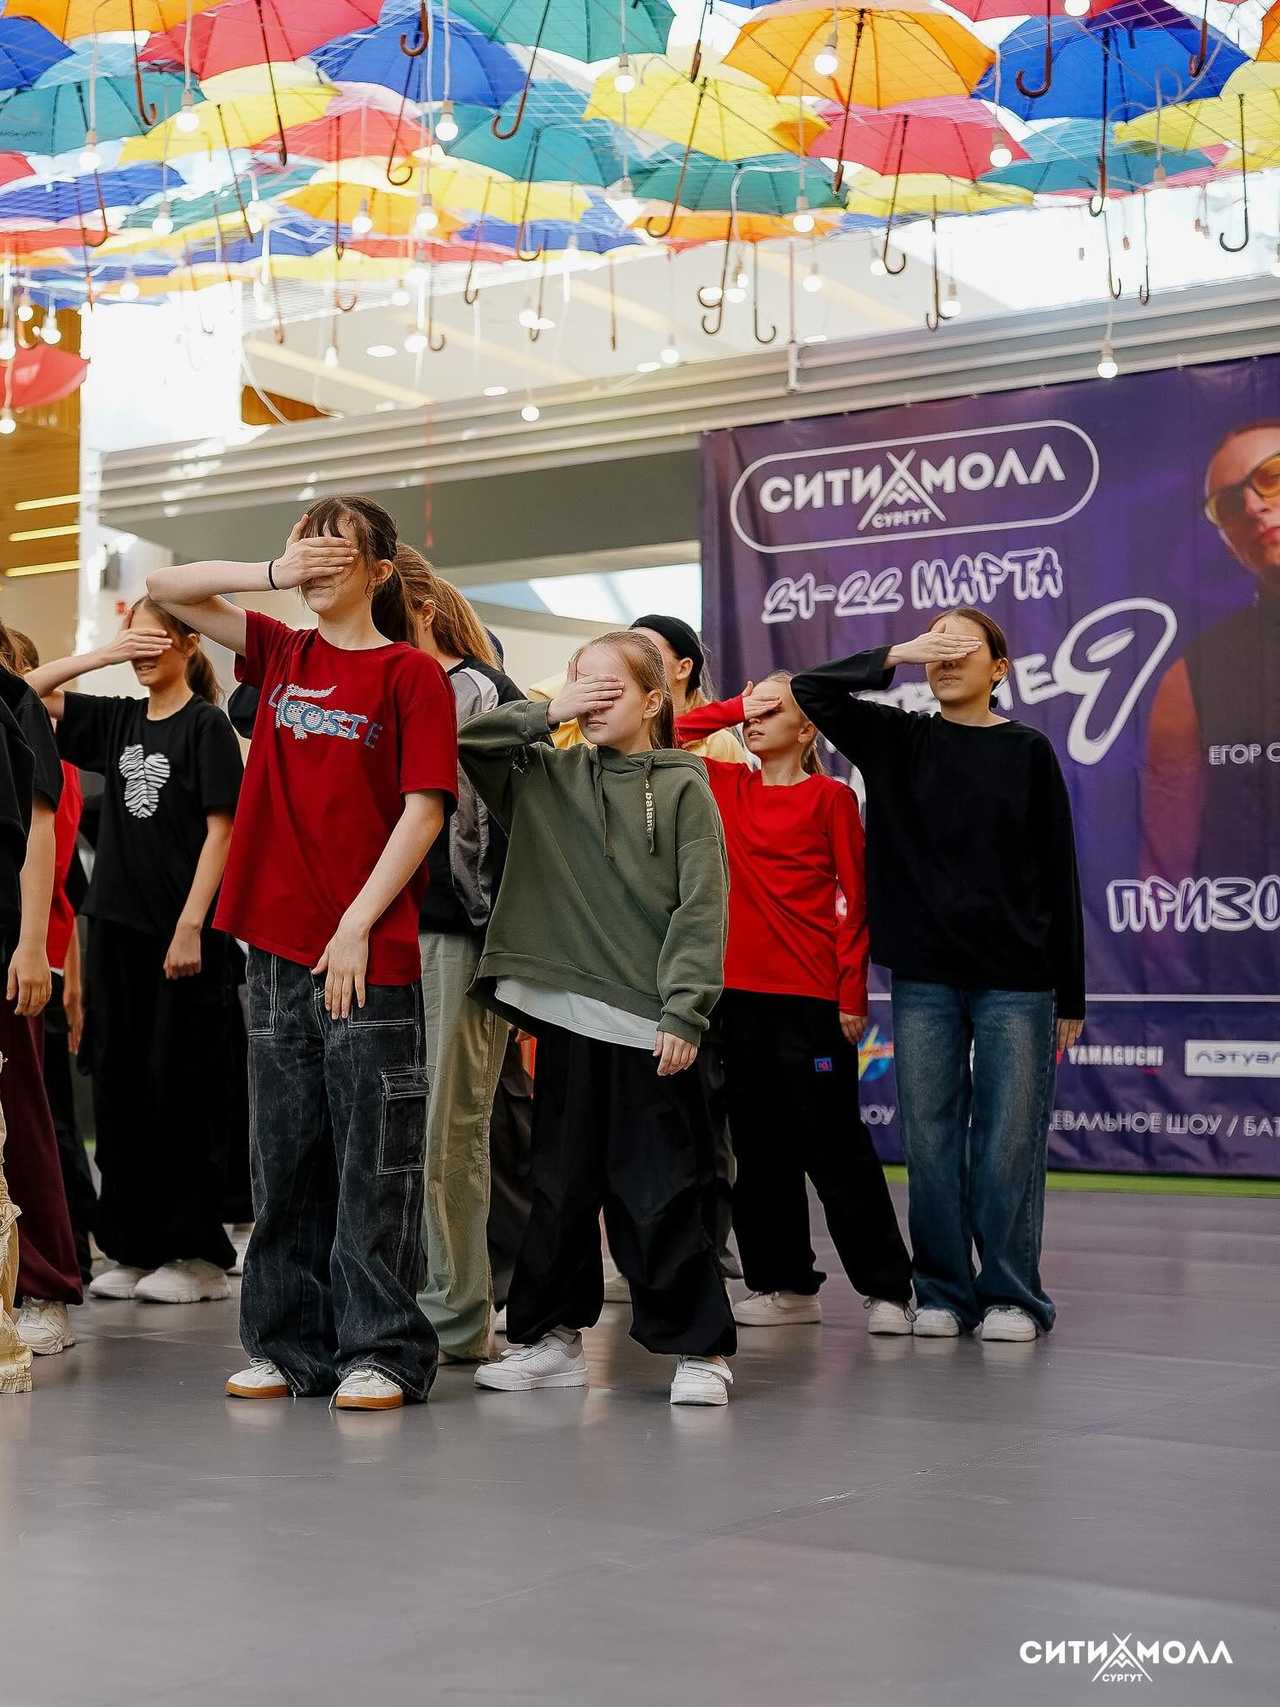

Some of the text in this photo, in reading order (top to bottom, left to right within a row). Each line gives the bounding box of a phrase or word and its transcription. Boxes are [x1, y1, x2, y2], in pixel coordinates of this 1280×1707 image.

[759, 443, 1066, 514] СИТИ МОЛЛ
[871, 507, 934, 529] СУРГУТ
[761, 546, 1063, 623] 21-22 МАРТА
[268, 683, 384, 749] LCOSTE
[1208, 743, 1262, 765] ЕГОР
[1106, 874, 1280, 933] ПРИЗО
[1066, 1044, 1165, 1067] YAMAGUCHI
[1049, 1109, 1162, 1134] ЕВАЛЬНОЕ
[1166, 1113, 1223, 1135] ШОУ
